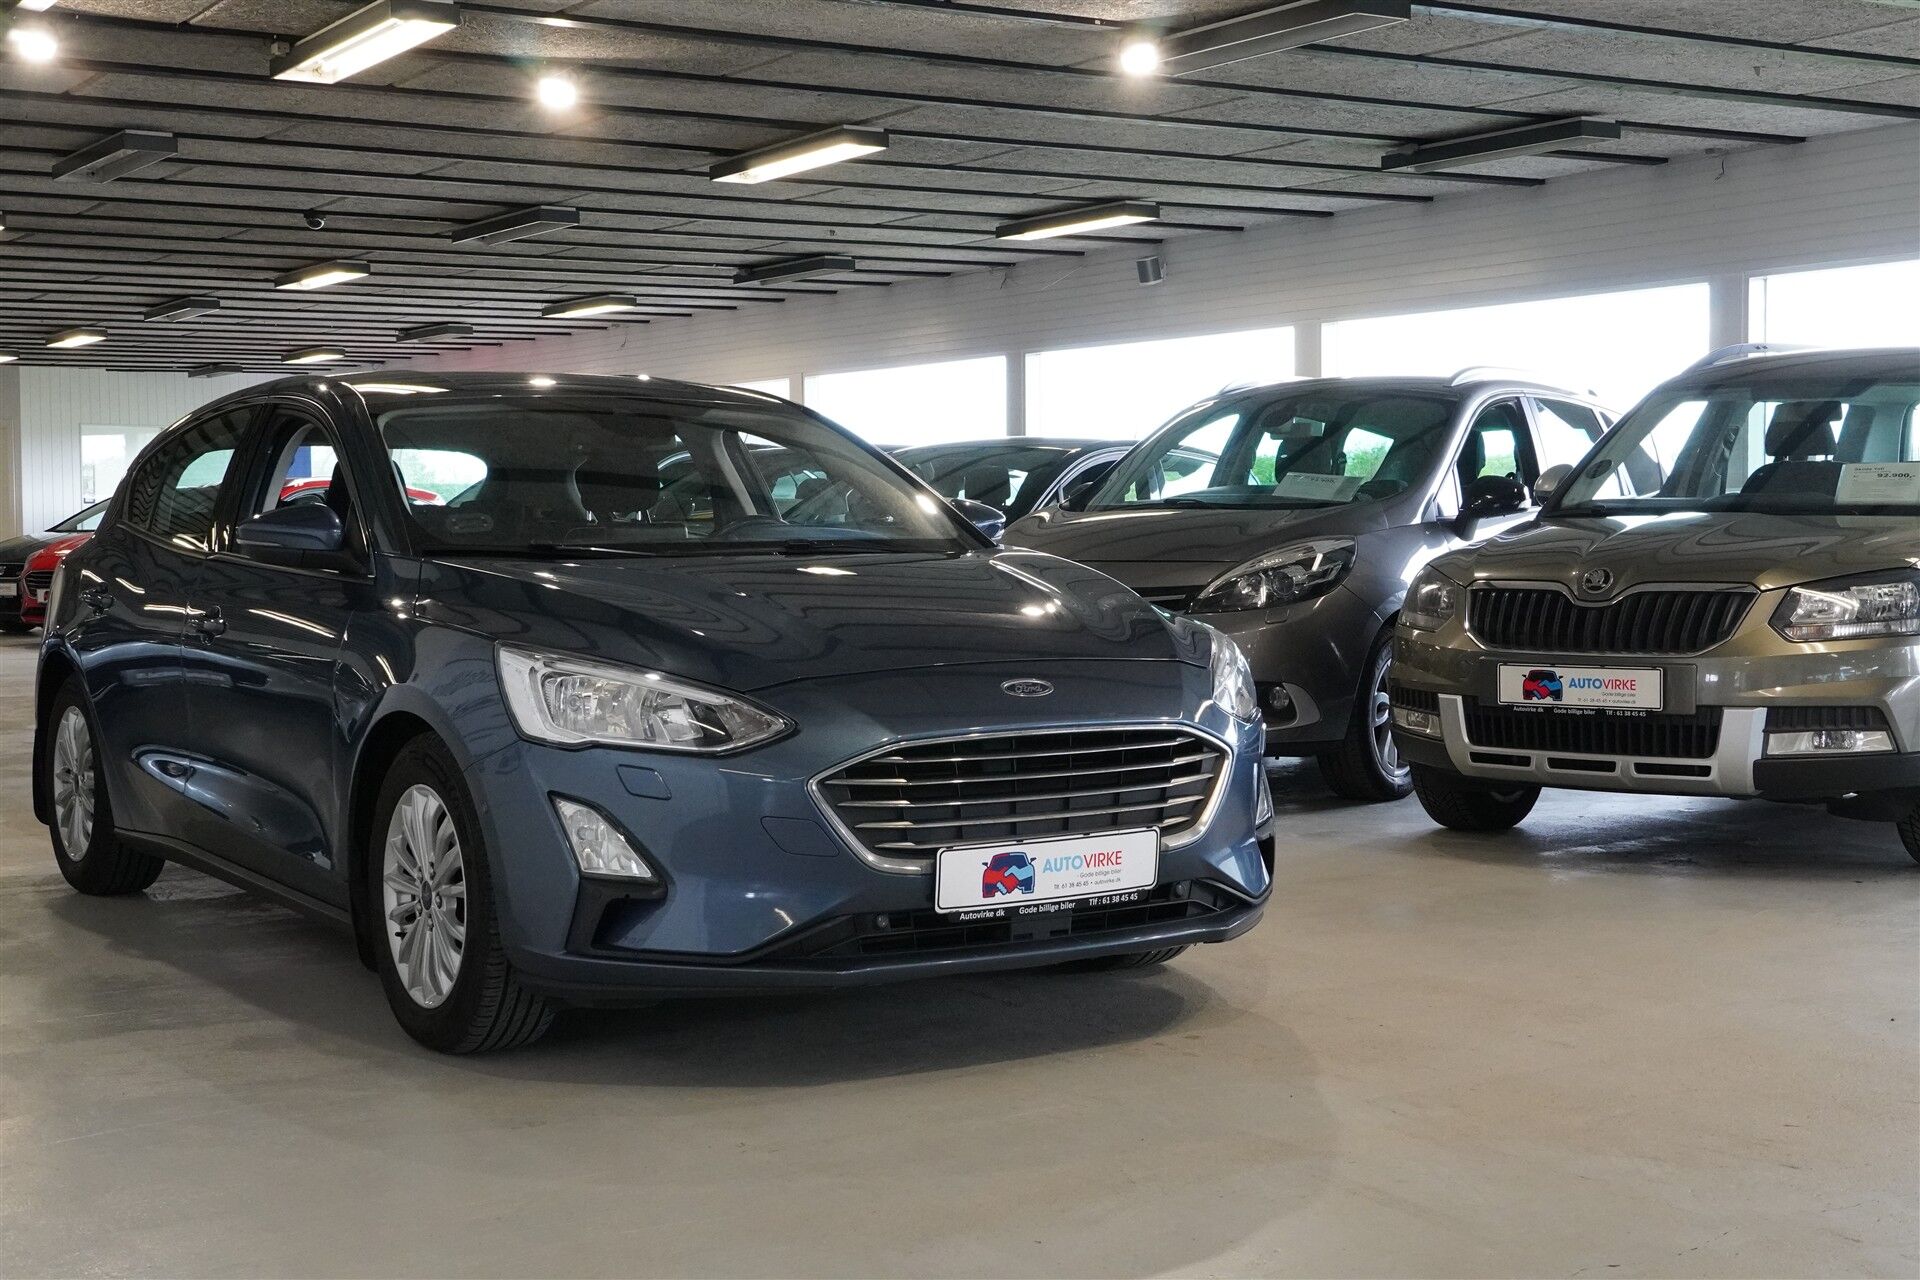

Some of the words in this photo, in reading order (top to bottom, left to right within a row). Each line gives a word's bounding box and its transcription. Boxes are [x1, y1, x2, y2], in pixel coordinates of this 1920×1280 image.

[1568, 677, 1637, 691] AUTOVIRKE
[1567, 708, 1583, 716] billige
[1042, 850, 1122, 874] AUTOVIRKE
[960, 910, 995, 920] Autovirke
[1018, 905, 1038, 914] Gode
[1038, 902, 1059, 913] billige
[1060, 901, 1076, 910] biler
[1102, 896, 1111, 905] 61
[1111, 895, 1120, 903] 38
[1120, 894, 1129, 902] 45
[1129, 892, 1138, 901] 45
